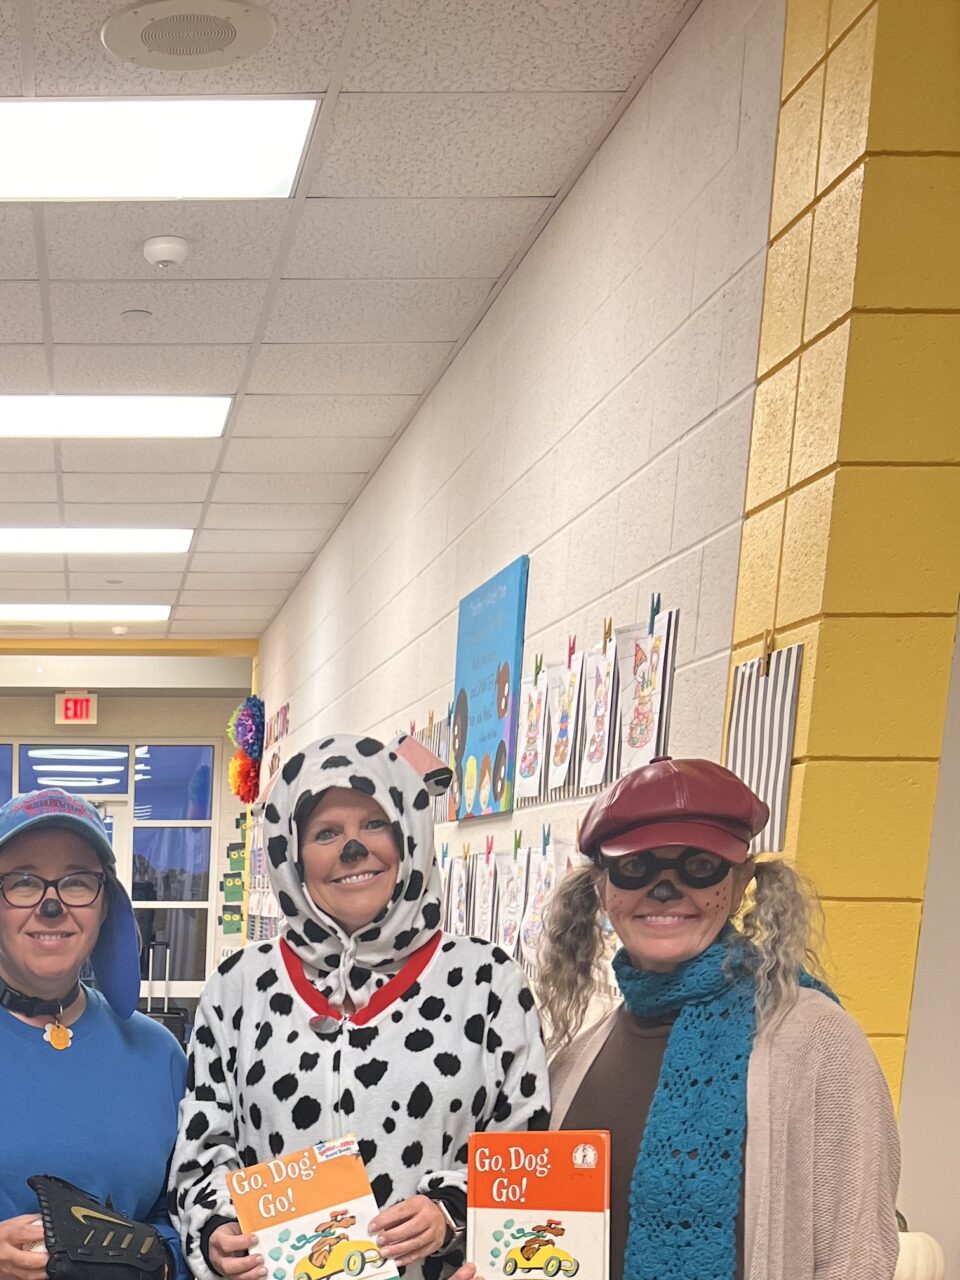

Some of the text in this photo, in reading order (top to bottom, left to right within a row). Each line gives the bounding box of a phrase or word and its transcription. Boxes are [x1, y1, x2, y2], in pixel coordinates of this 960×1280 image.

[64, 698, 91, 720] EXIT
[231, 1152, 317, 1196] Go, Dog.
[475, 1147, 506, 1173] Go,
[508, 1146, 551, 1177] Dog.
[258, 1187, 296, 1219] Go!
[492, 1176, 528, 1203] Go!
